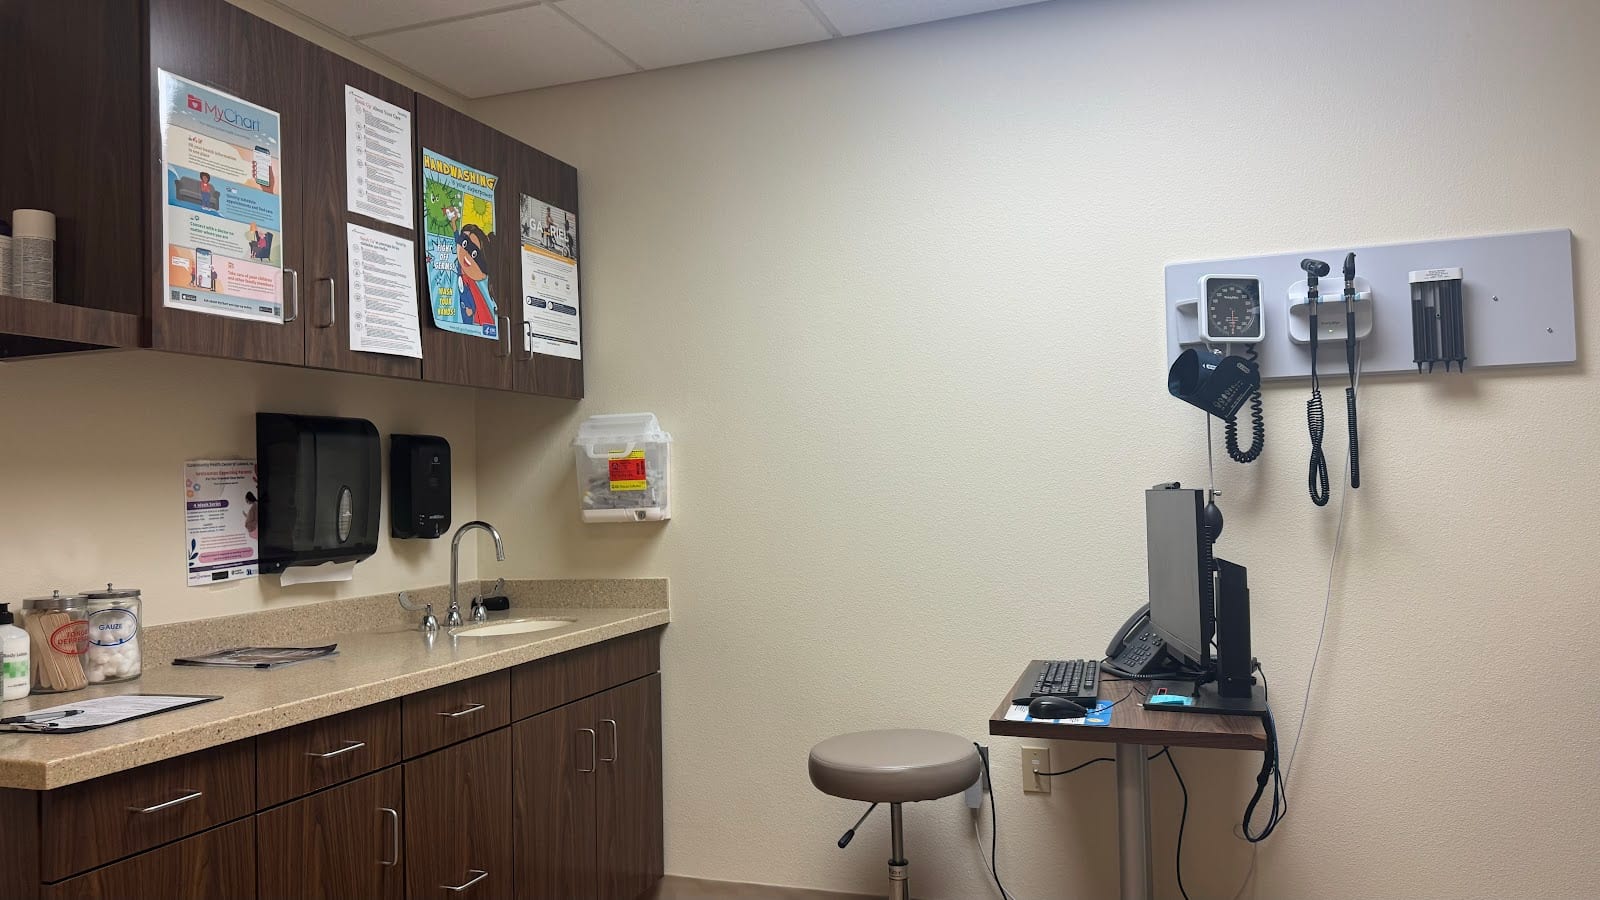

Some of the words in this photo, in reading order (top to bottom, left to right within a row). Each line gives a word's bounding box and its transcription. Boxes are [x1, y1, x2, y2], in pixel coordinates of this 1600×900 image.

[204, 102, 259, 131] MyChart
[424, 154, 496, 190] HANDWASHING
[530, 219, 569, 242] GARIEL
[437, 244, 452, 252] FIGHT
[434, 262, 456, 270] GERMS!
[438, 288, 453, 296] WASH
[439, 298, 452, 306] YOUR
[438, 308, 456, 316] HANDS!
[98, 623, 123, 631] GAUZE
